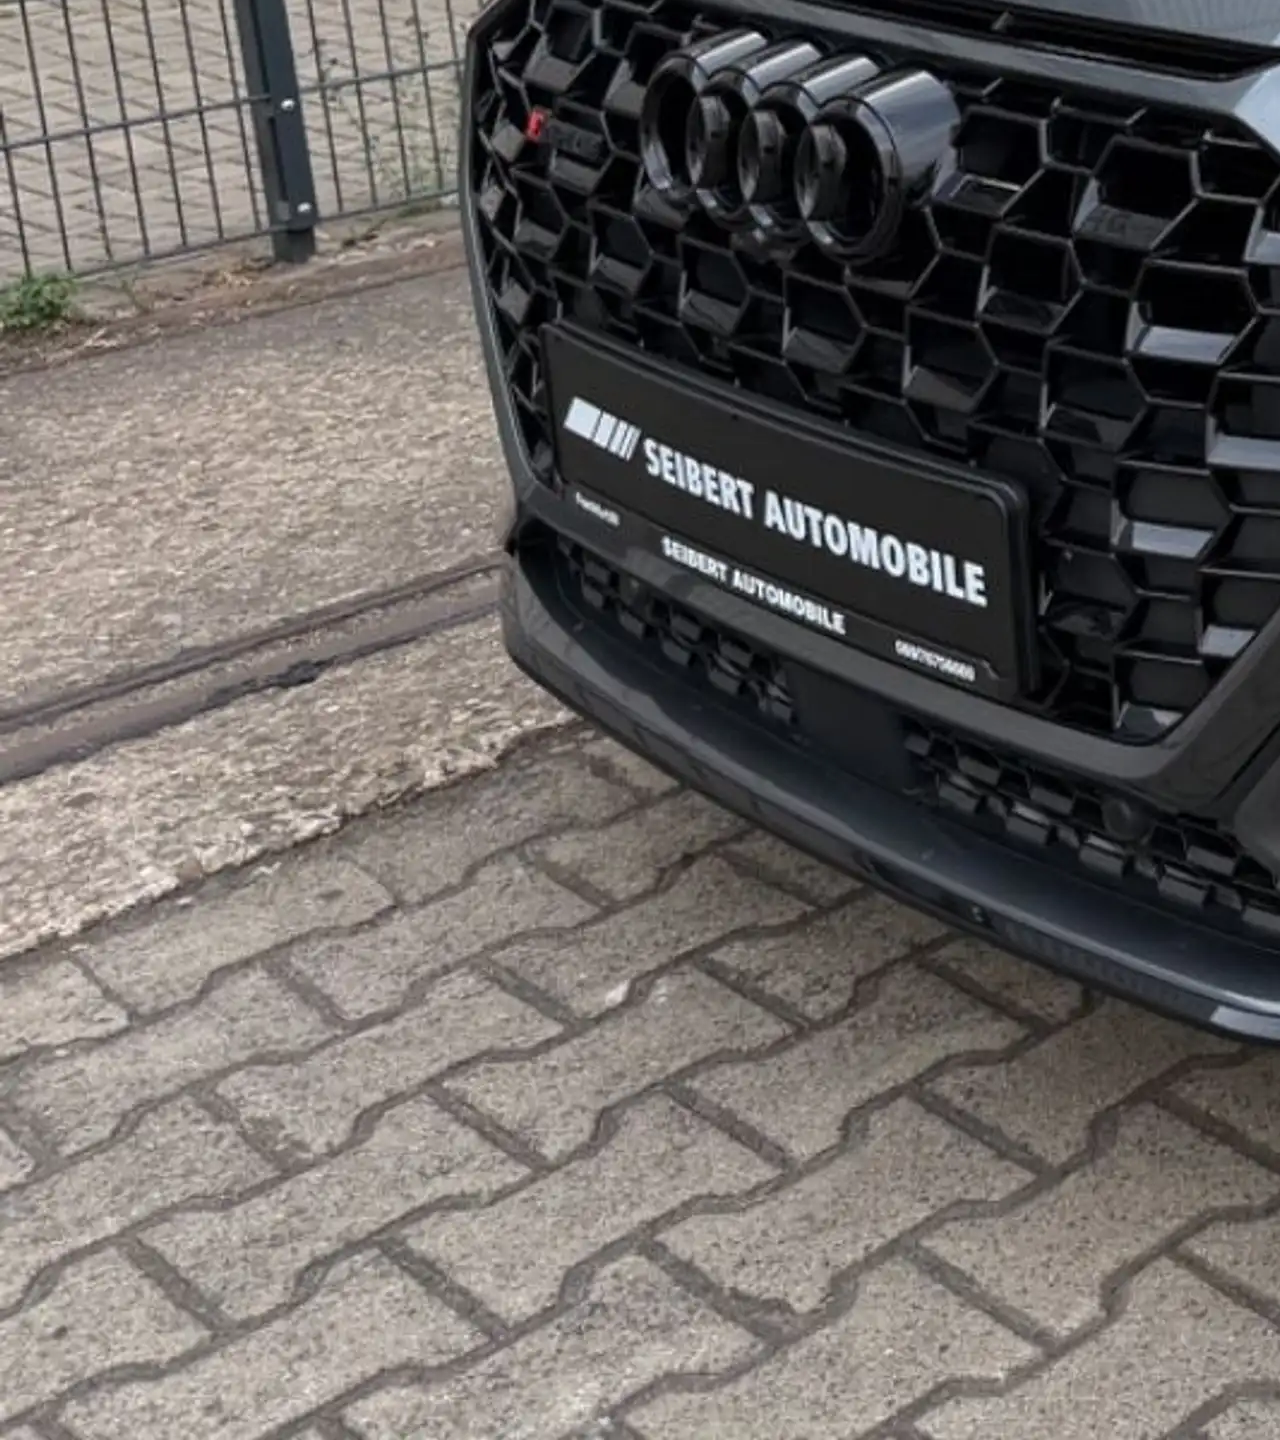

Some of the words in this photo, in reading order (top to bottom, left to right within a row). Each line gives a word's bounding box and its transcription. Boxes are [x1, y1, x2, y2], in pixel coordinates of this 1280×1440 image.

[643, 437, 754, 520] SEIBERT
[764, 490, 988, 608] AUTOMOBILE
[660, 535, 728, 582] SEIBERT
[732, 568, 846, 636] AUTOMOBILE
